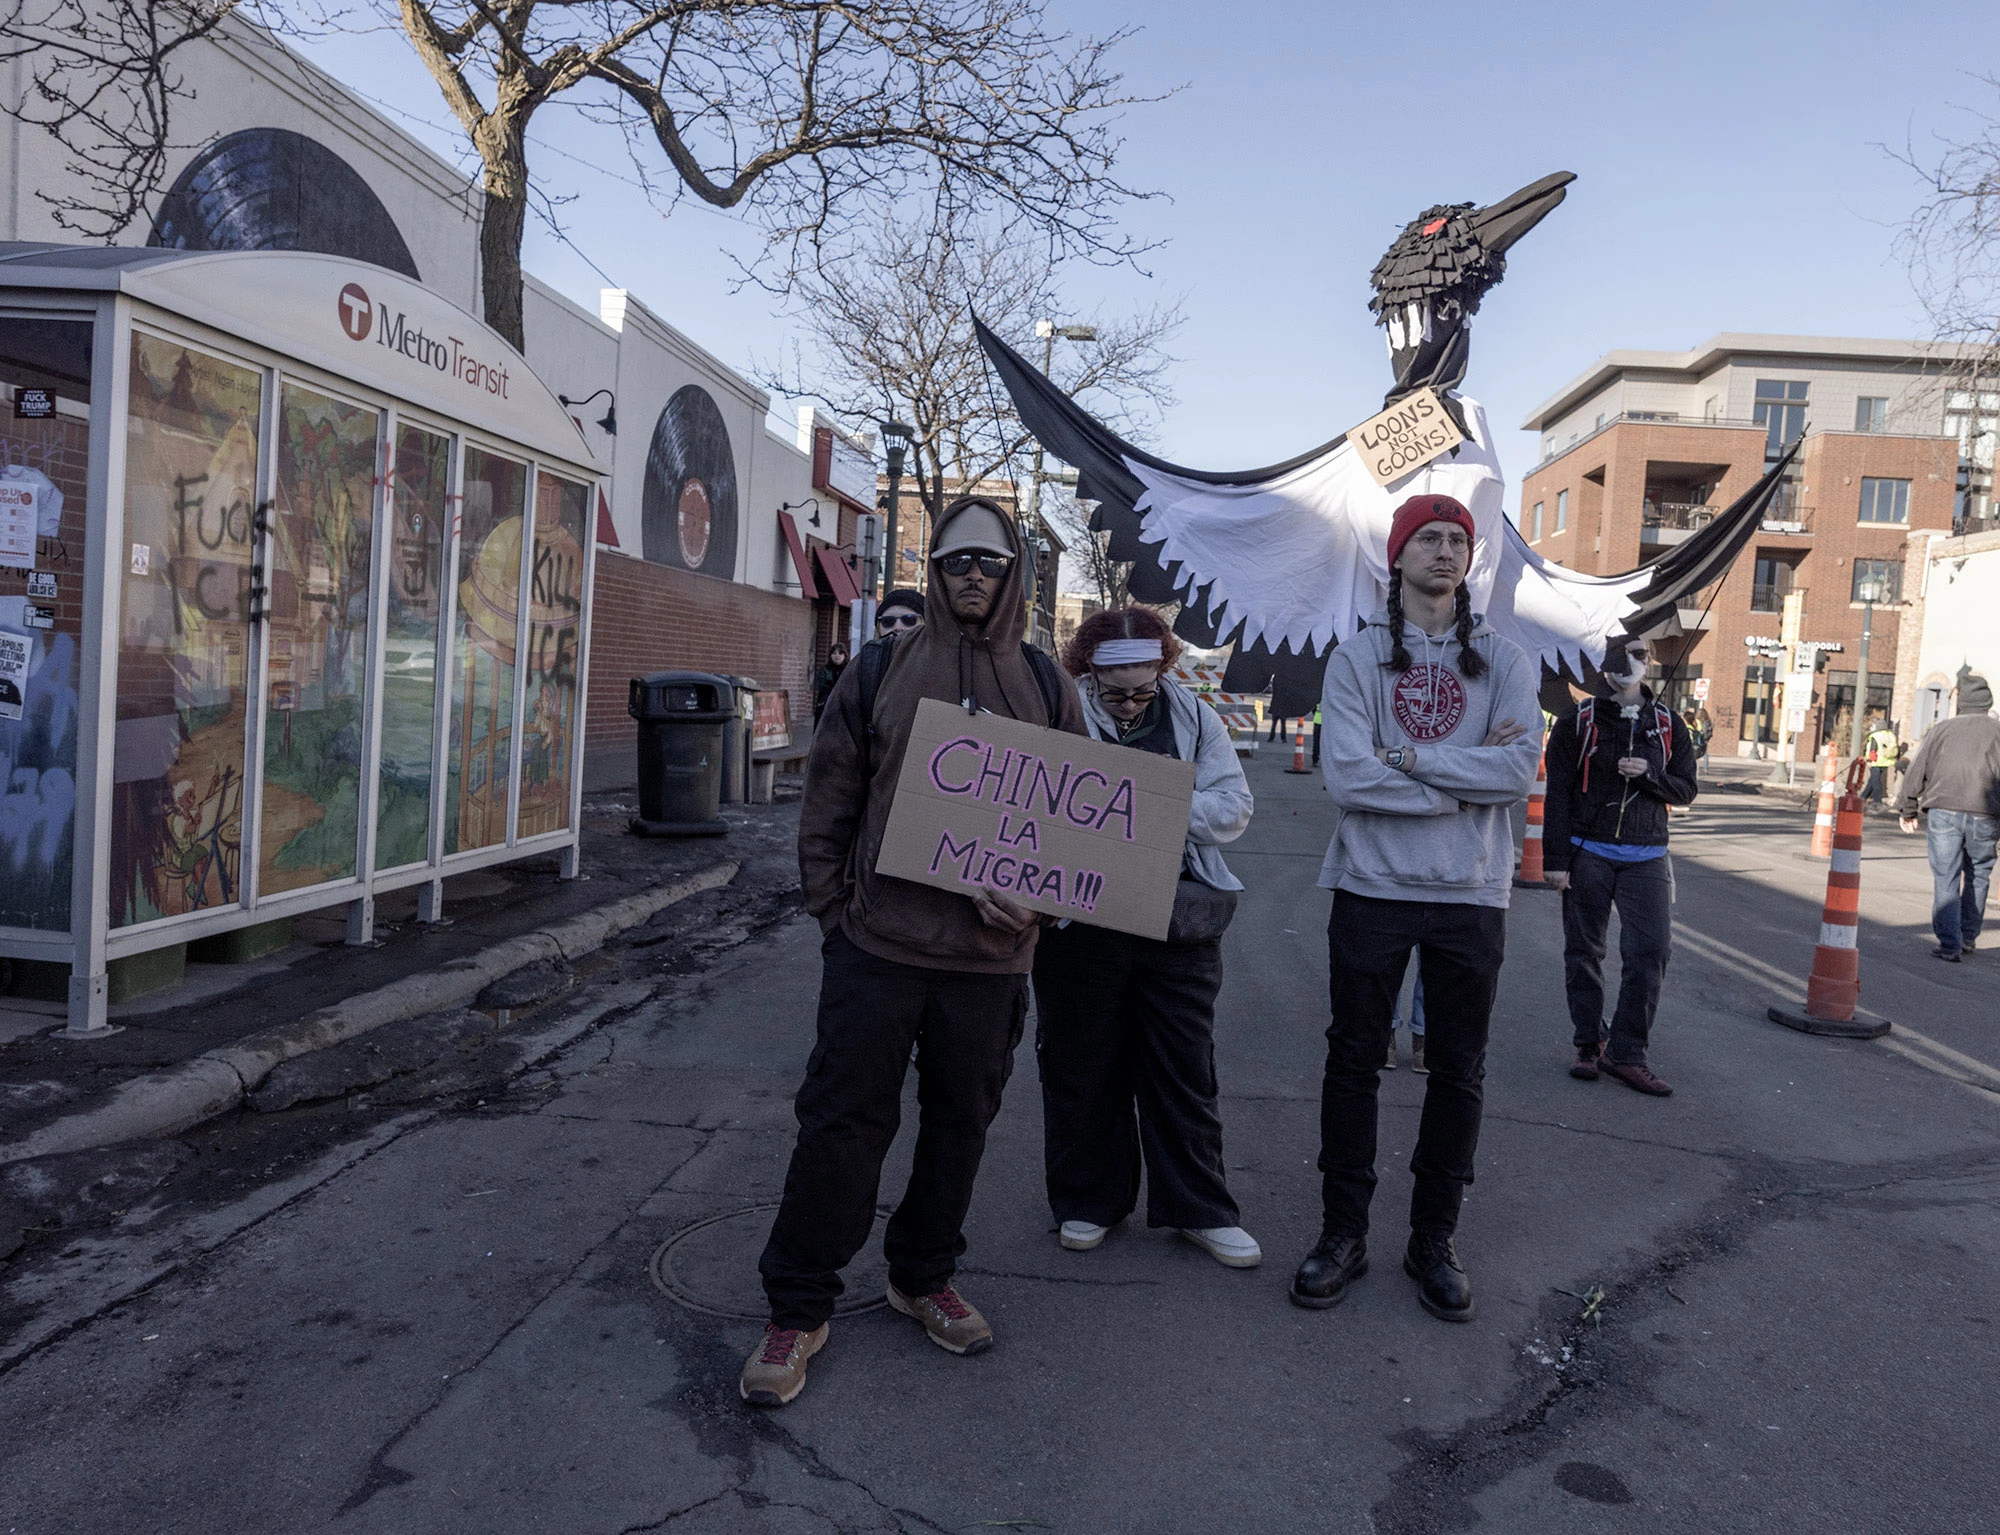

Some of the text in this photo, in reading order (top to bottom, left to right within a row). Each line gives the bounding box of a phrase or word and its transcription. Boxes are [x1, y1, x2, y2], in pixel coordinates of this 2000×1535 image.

[20, 401, 52, 410] TRUMP
[24, 393, 47, 402] FUCK
[1360, 397, 1435, 450] LOONS
[1377, 418, 1454, 477] GOONS!
[1388, 426, 1418, 451] NOT
[531, 538, 582, 614] KILL
[525, 620, 578, 693] ICE
[928, 736, 1137, 842] CHINGA
[995, 812, 1041, 853] LA
